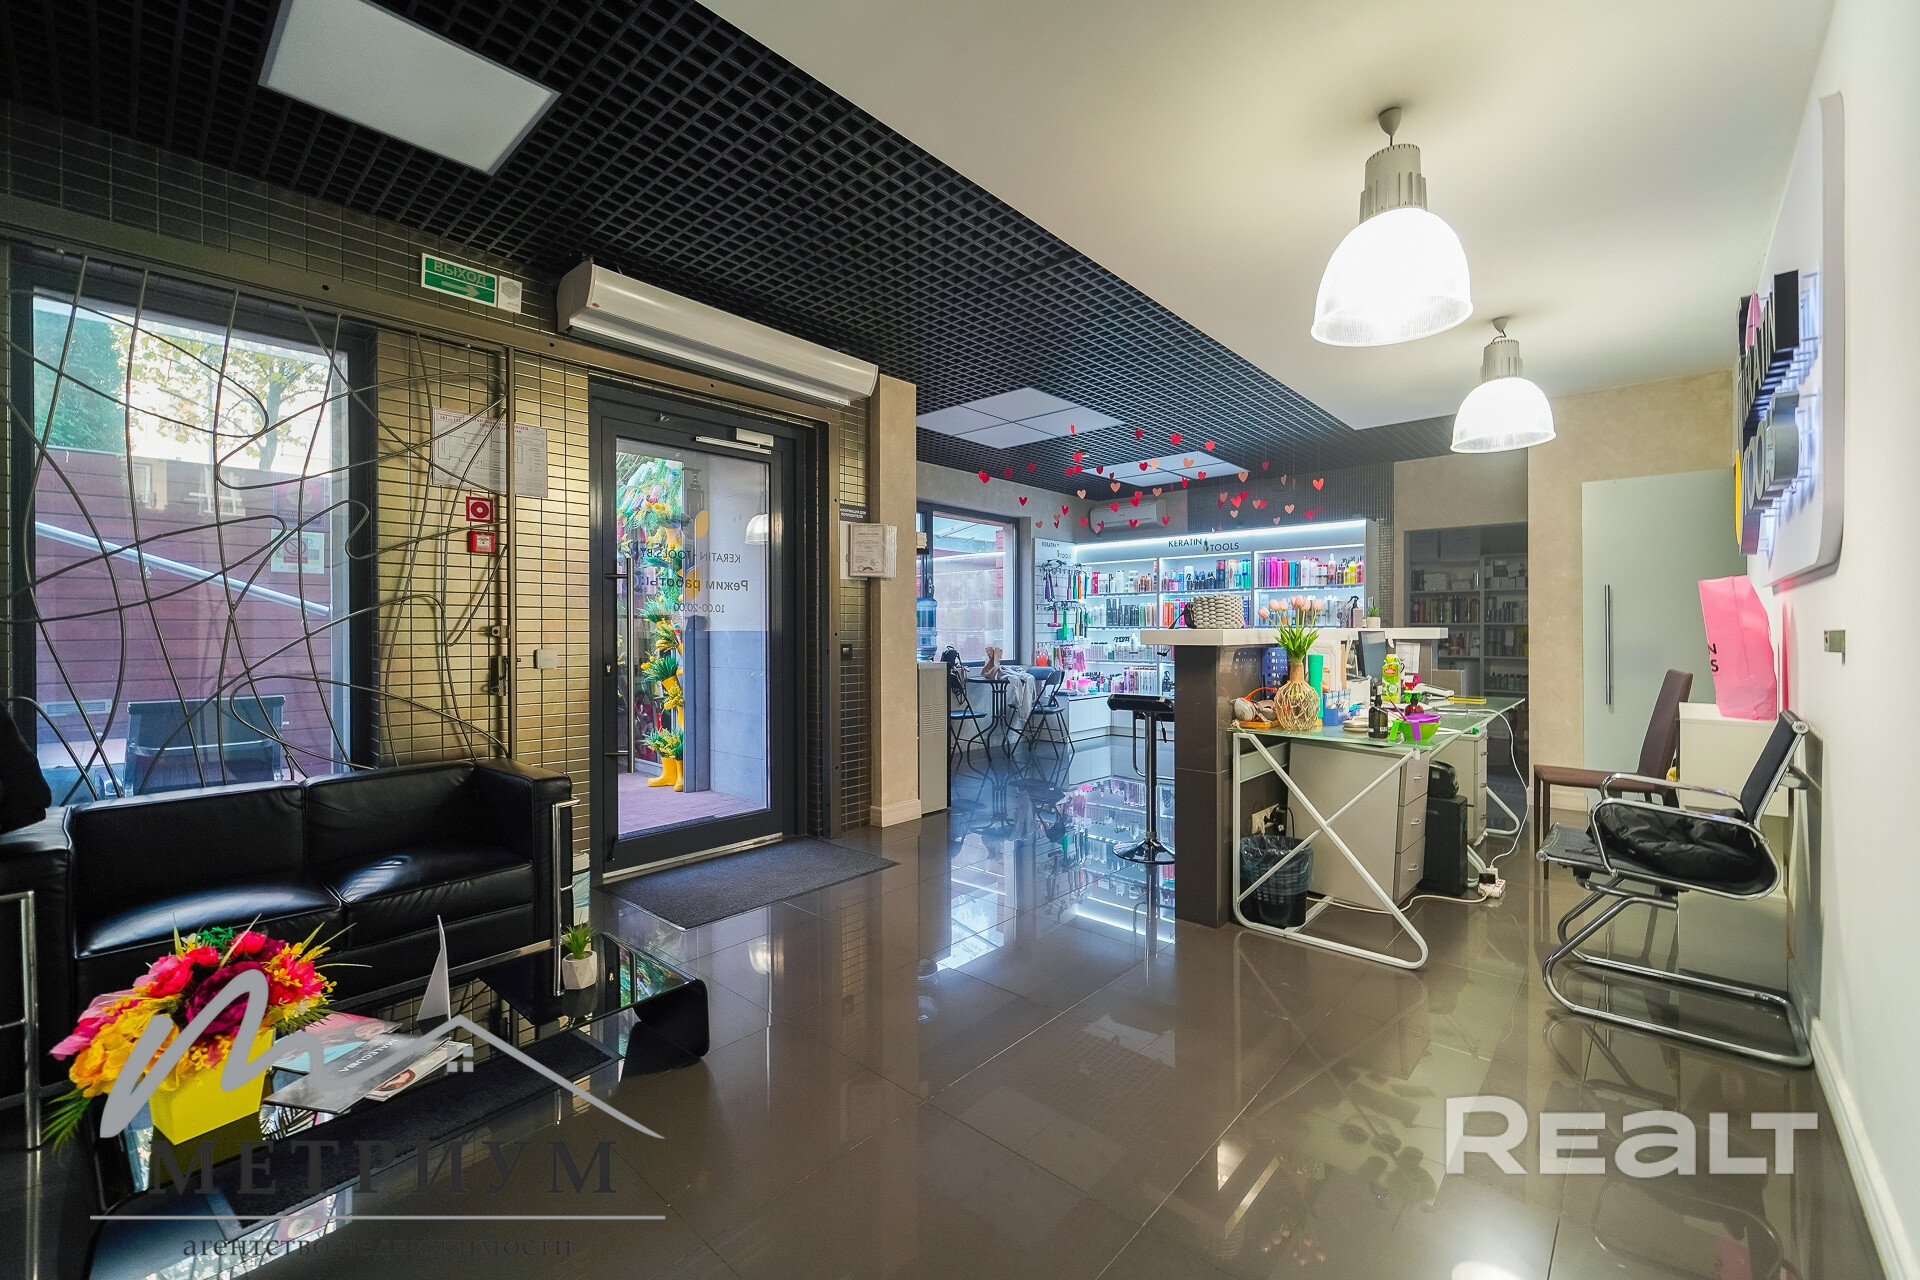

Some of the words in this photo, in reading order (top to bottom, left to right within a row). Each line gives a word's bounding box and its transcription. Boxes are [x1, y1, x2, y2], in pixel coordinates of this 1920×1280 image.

[433, 260, 487, 287] ВЫХОД
[1168, 538, 1203, 548] KERATIN
[1209, 542, 1240, 552] TOOLS
